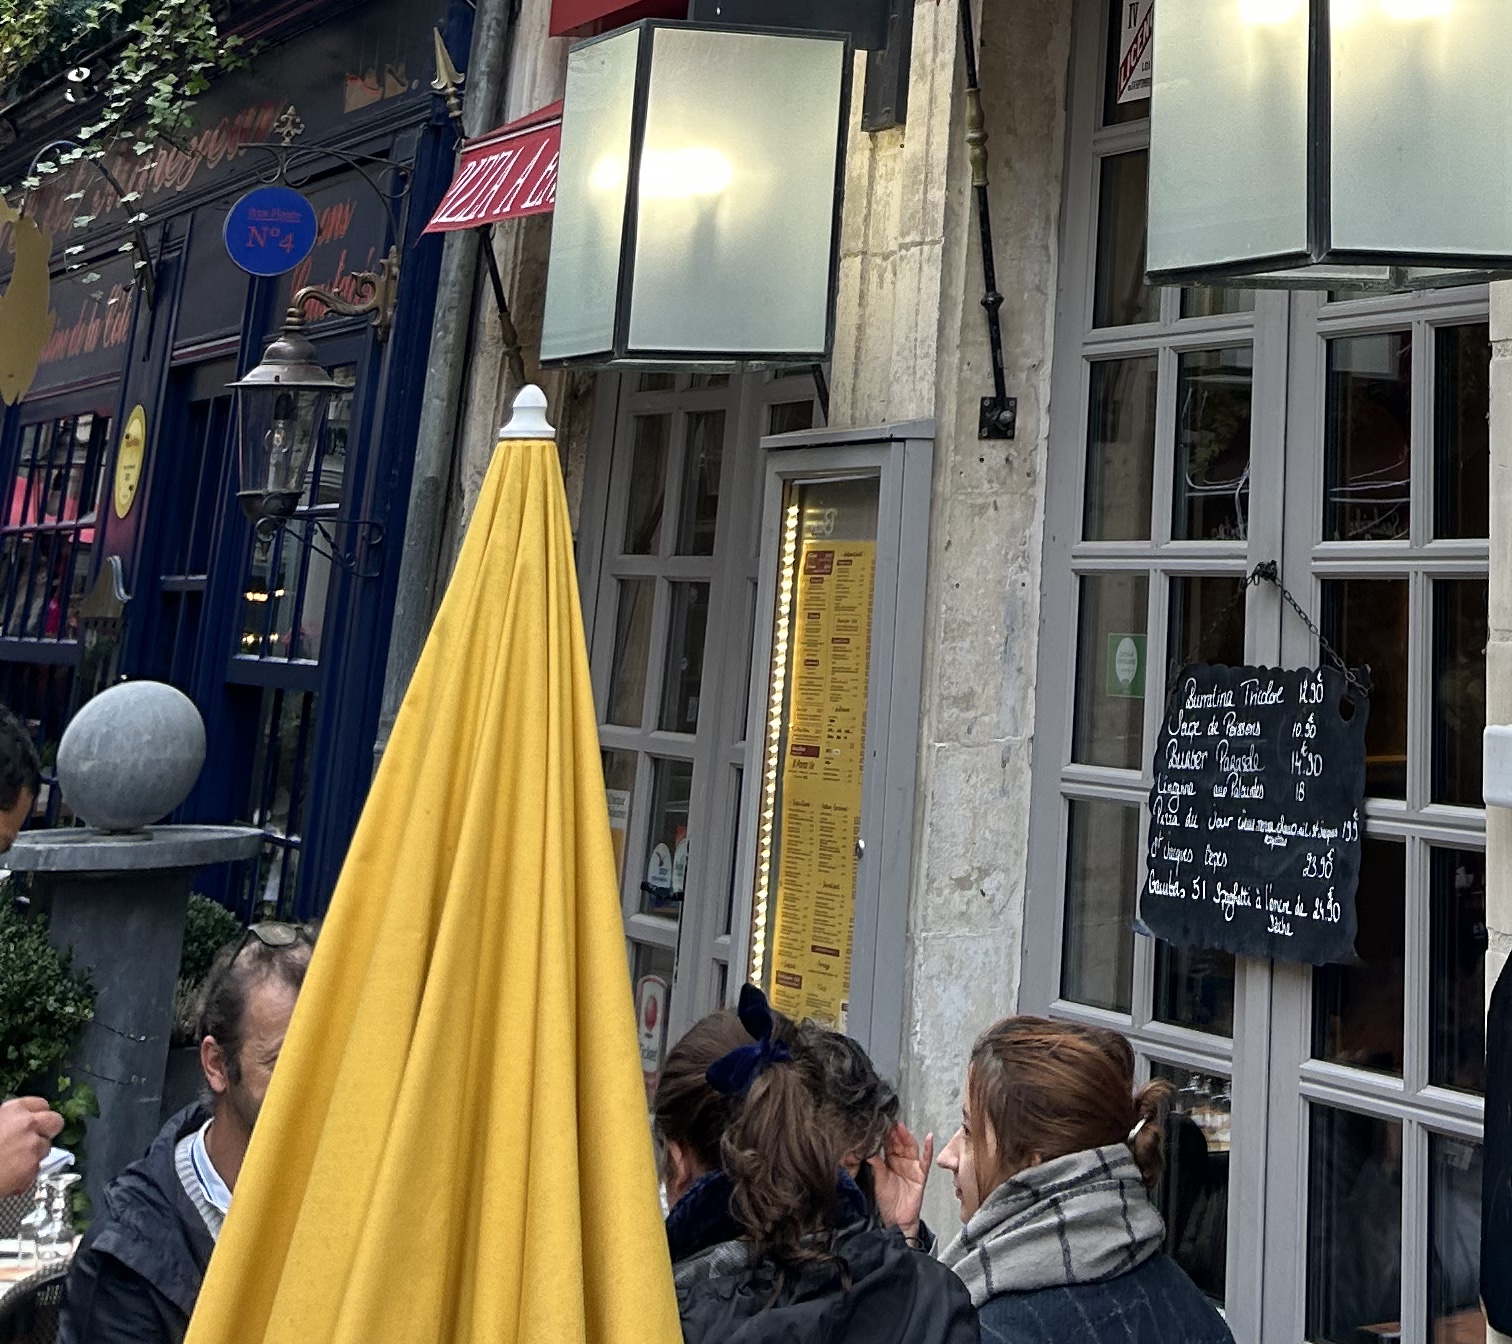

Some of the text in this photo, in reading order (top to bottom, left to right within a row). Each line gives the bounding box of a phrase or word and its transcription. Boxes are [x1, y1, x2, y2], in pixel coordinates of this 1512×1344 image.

[1127, 1, 1139, 30] IV
[1119, 7, 1153, 92] LICEN
[430, 145, 525, 225] PIZZA
[492, 137, 551, 215] A
[1207, 715, 1221, 736] de
[1294, 893, 1308, 918] de
